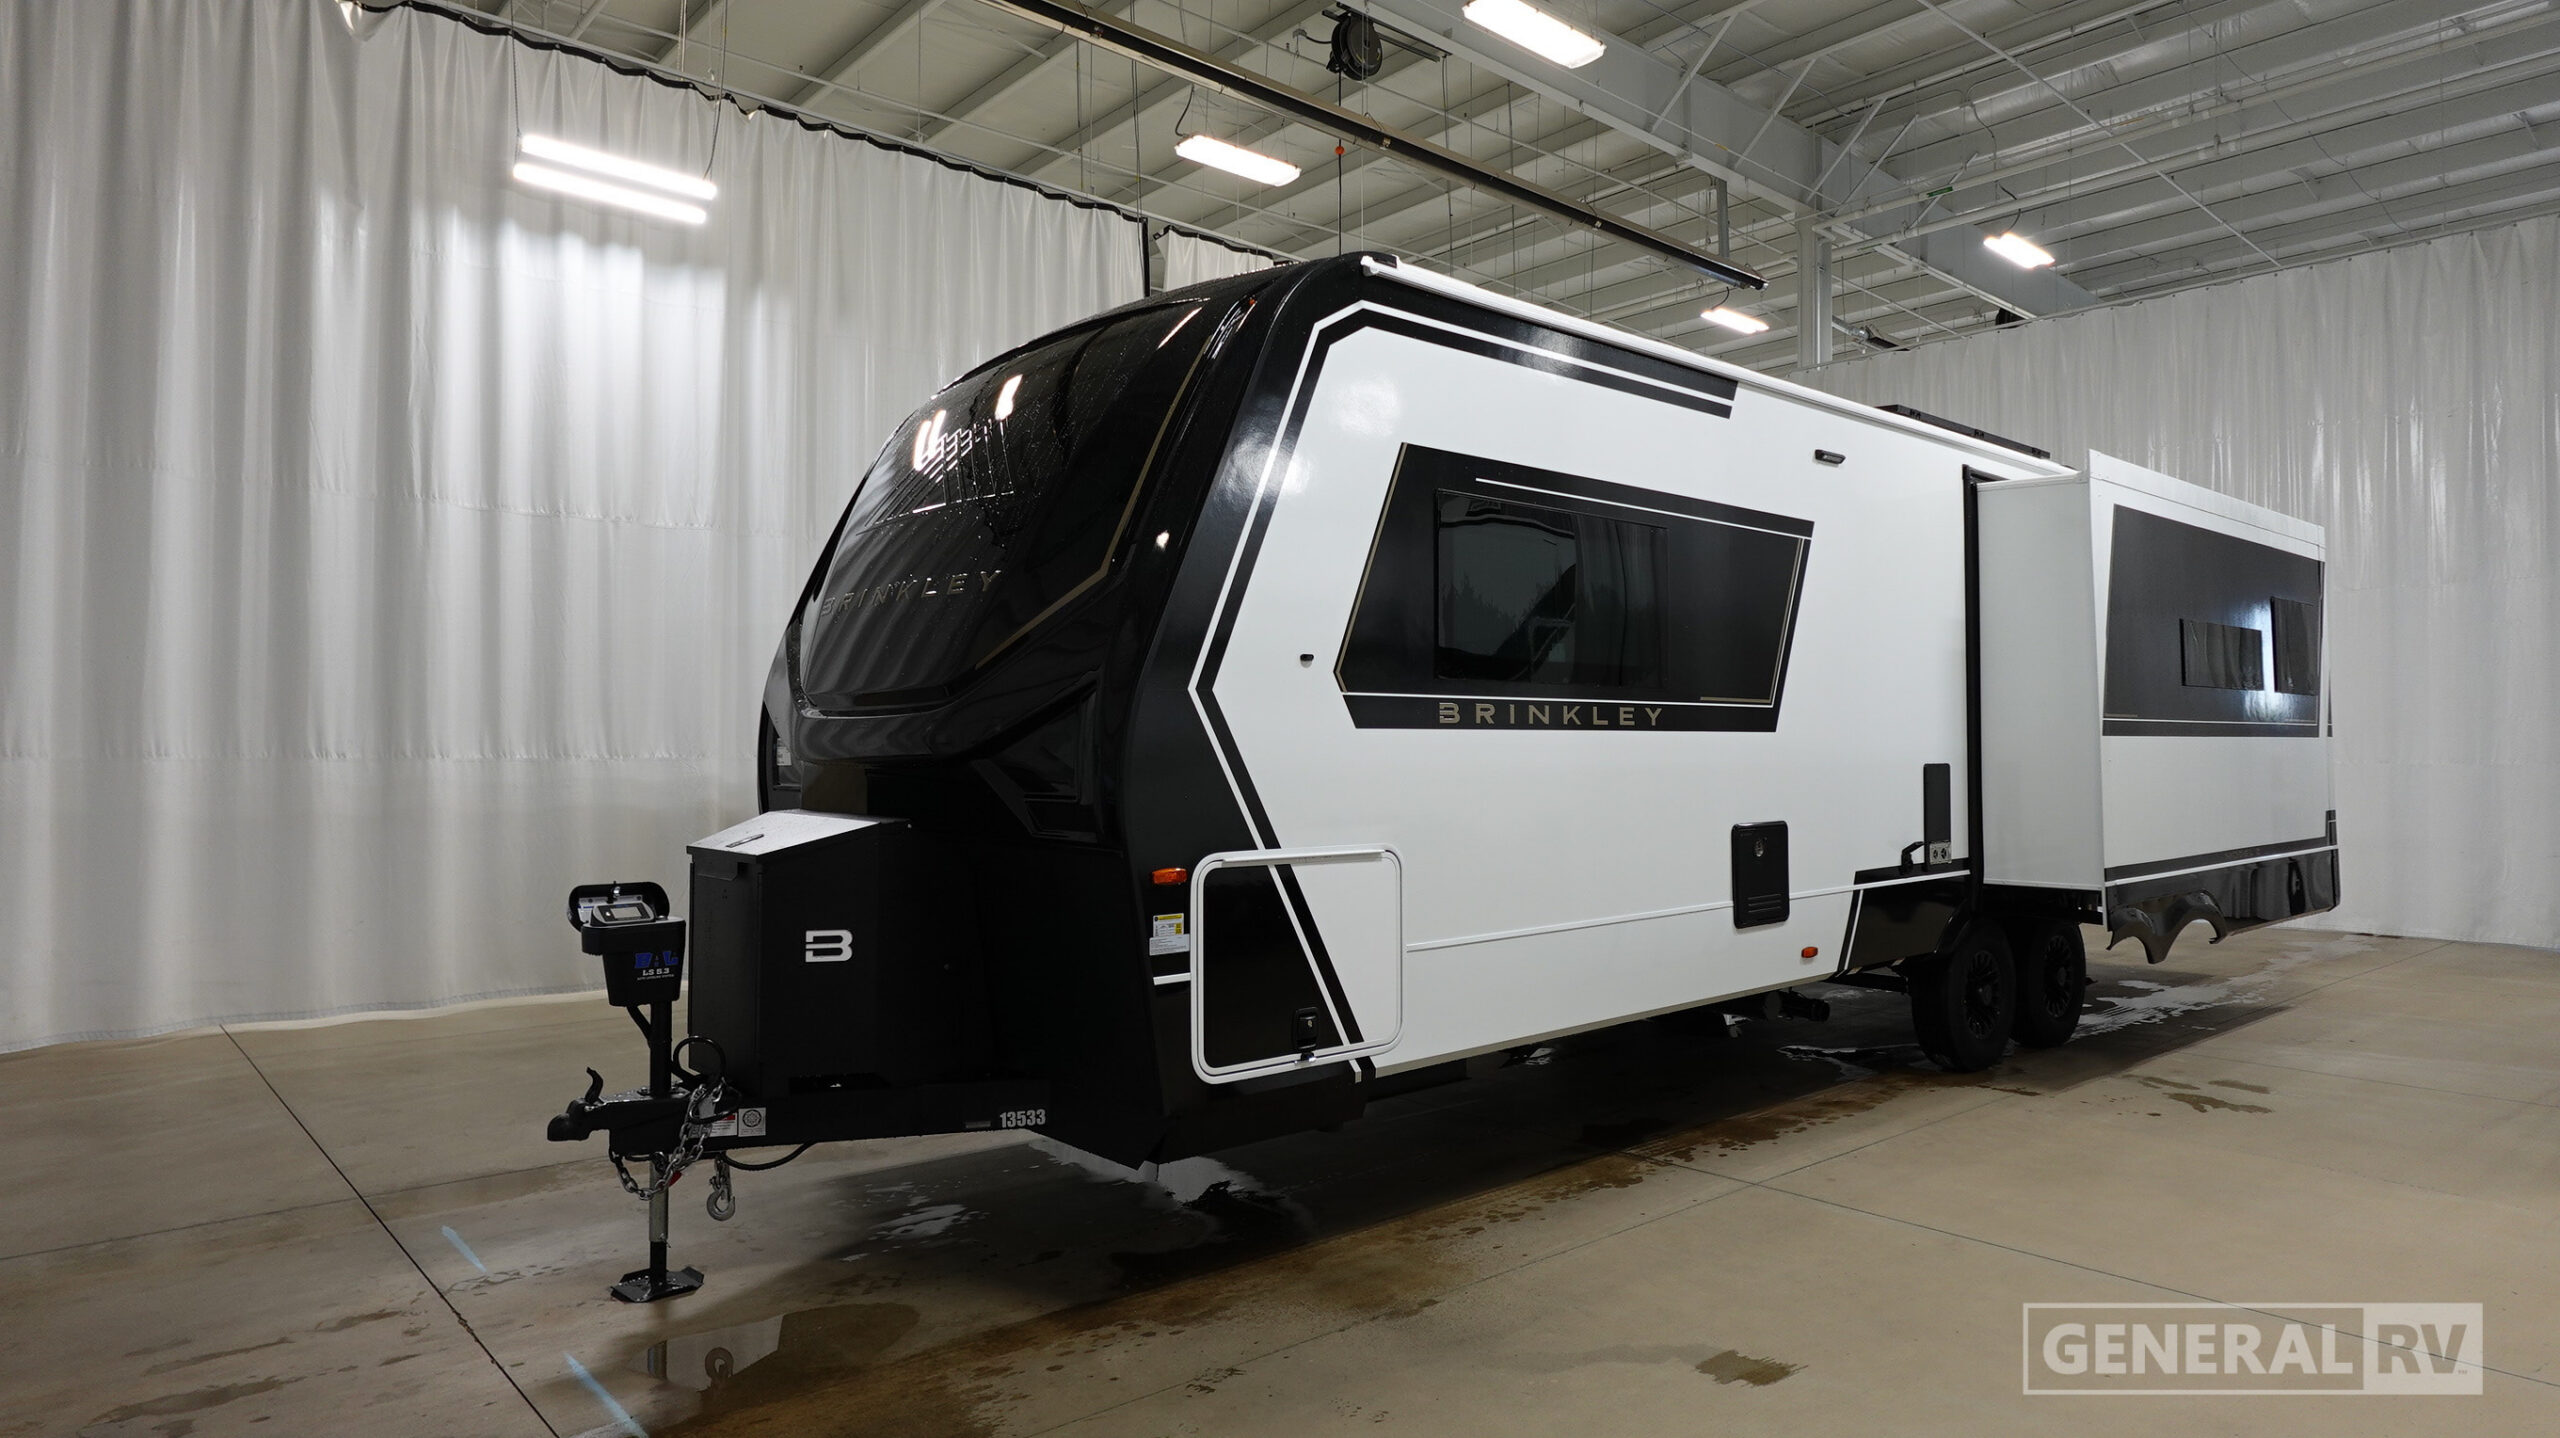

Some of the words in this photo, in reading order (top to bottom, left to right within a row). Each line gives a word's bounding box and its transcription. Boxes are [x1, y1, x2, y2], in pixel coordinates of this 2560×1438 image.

[821, 570, 1001, 617] BRINKLEY
[1439, 702, 1663, 727] BRINKLEY
[642, 968, 655, 977] LS
[1000, 1109, 1046, 1128] 13533
